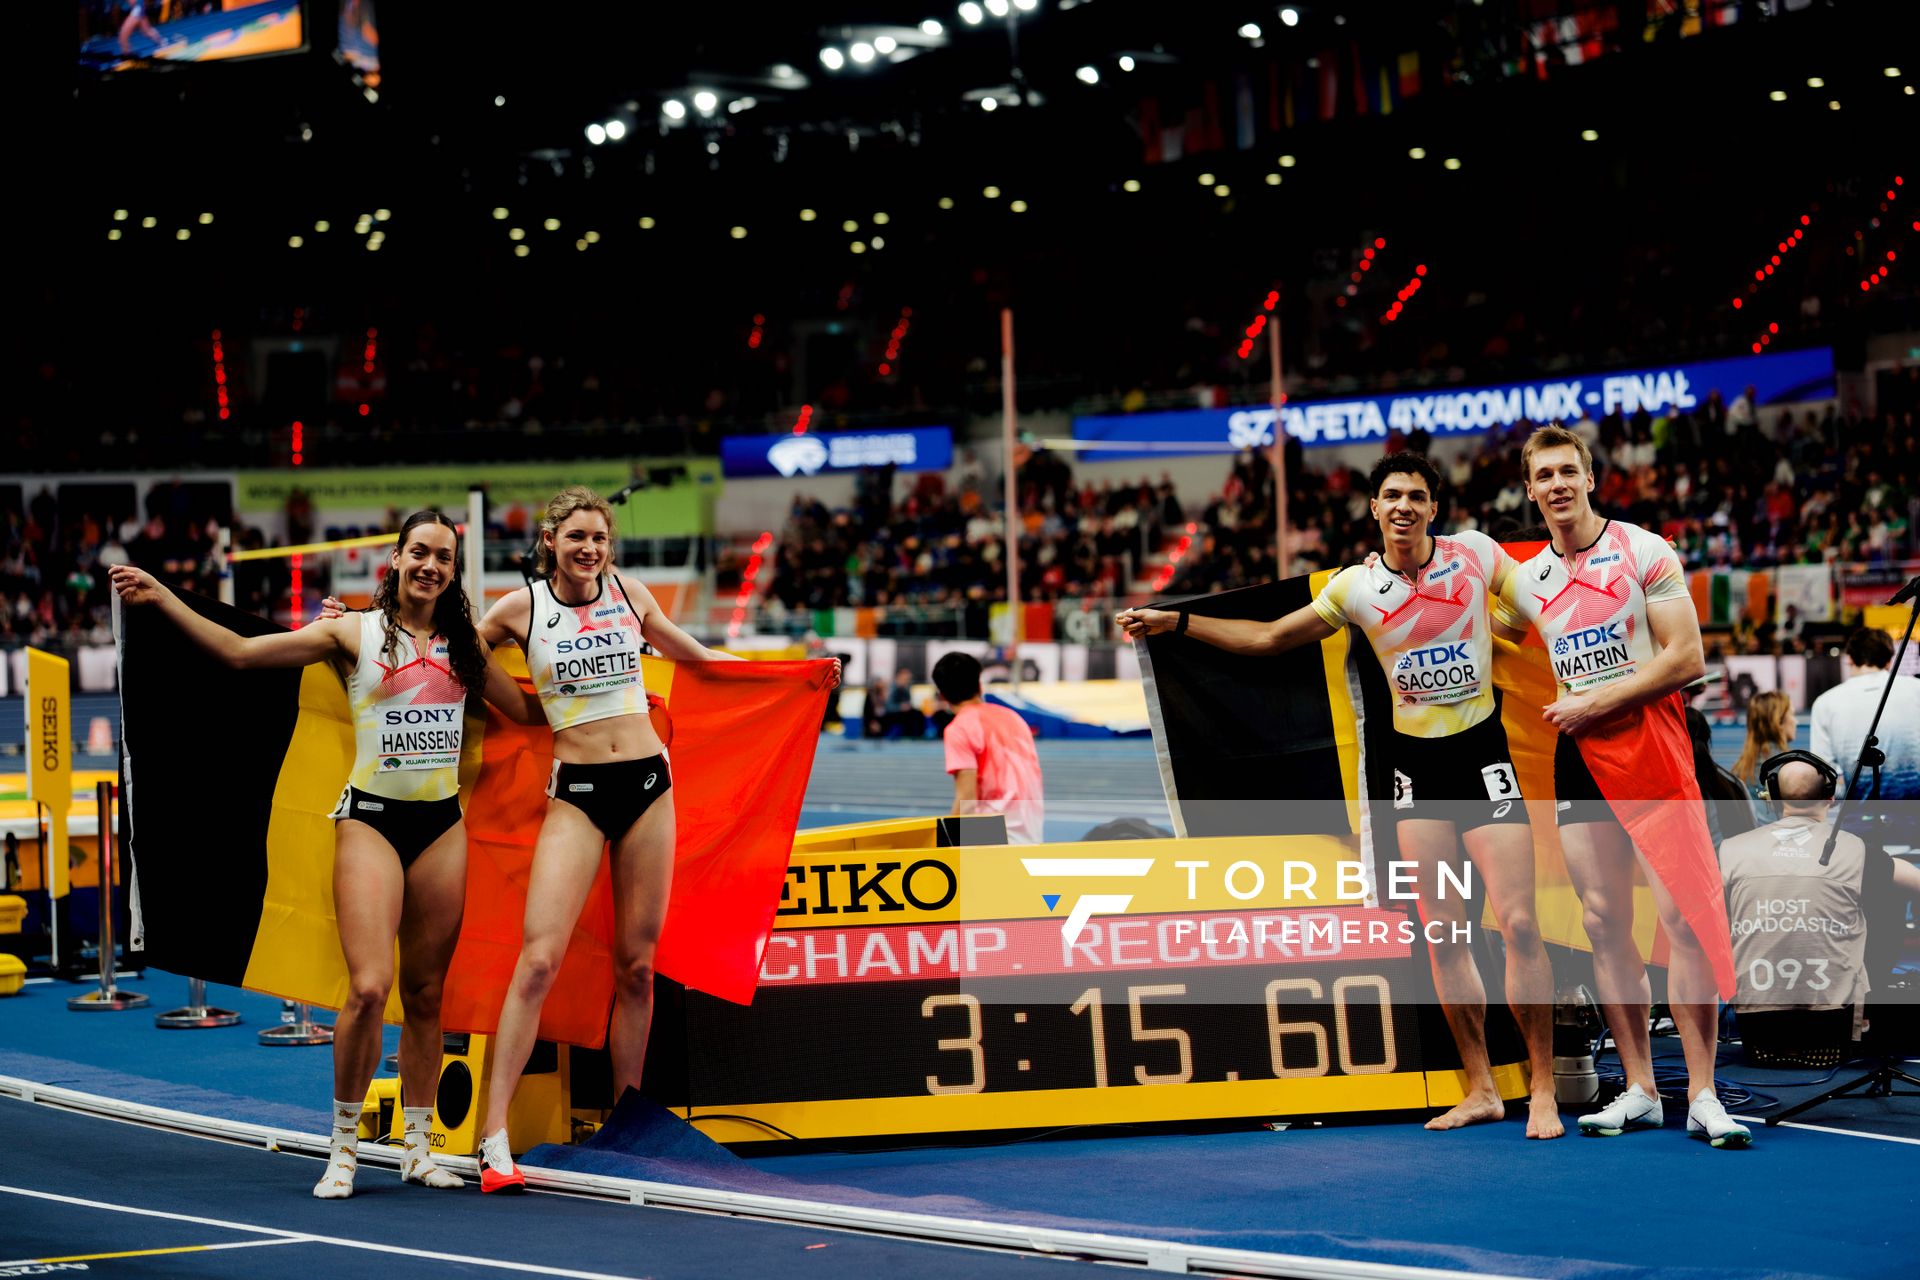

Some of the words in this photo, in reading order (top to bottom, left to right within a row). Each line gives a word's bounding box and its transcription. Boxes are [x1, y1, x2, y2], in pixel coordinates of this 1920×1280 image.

[1524, 381, 1583, 421] MIX
[1429, 566, 1451, 580] Allianz
[1590, 555, 1611, 566] Allianz
[556, 631, 627, 654] SONY
[1567, 623, 1622, 651] TDK
[556, 651, 636, 680] PONETTE
[1410, 642, 1470, 668] TDK
[1555, 643, 1629, 679] WATRIN
[580, 682, 605, 691] KUJAWY
[1397, 664, 1476, 691] SACOOR
[385, 709, 456, 725] SONY
[42, 696, 58, 772] SEIKO
[382, 730, 460, 753] HANSSENS
[1494, 768, 1512, 794] 3
[776, 859, 957, 916] EIKO
[1756, 899, 1810, 915] HOST
[1731, 917, 1849, 937] ROADCASTER
[756, 928, 1023, 980] CHAMP.
[1061, 913, 1344, 968] RECORD
[1750, 958, 1832, 991] 093
[429, 1132, 446, 1148] IKO
